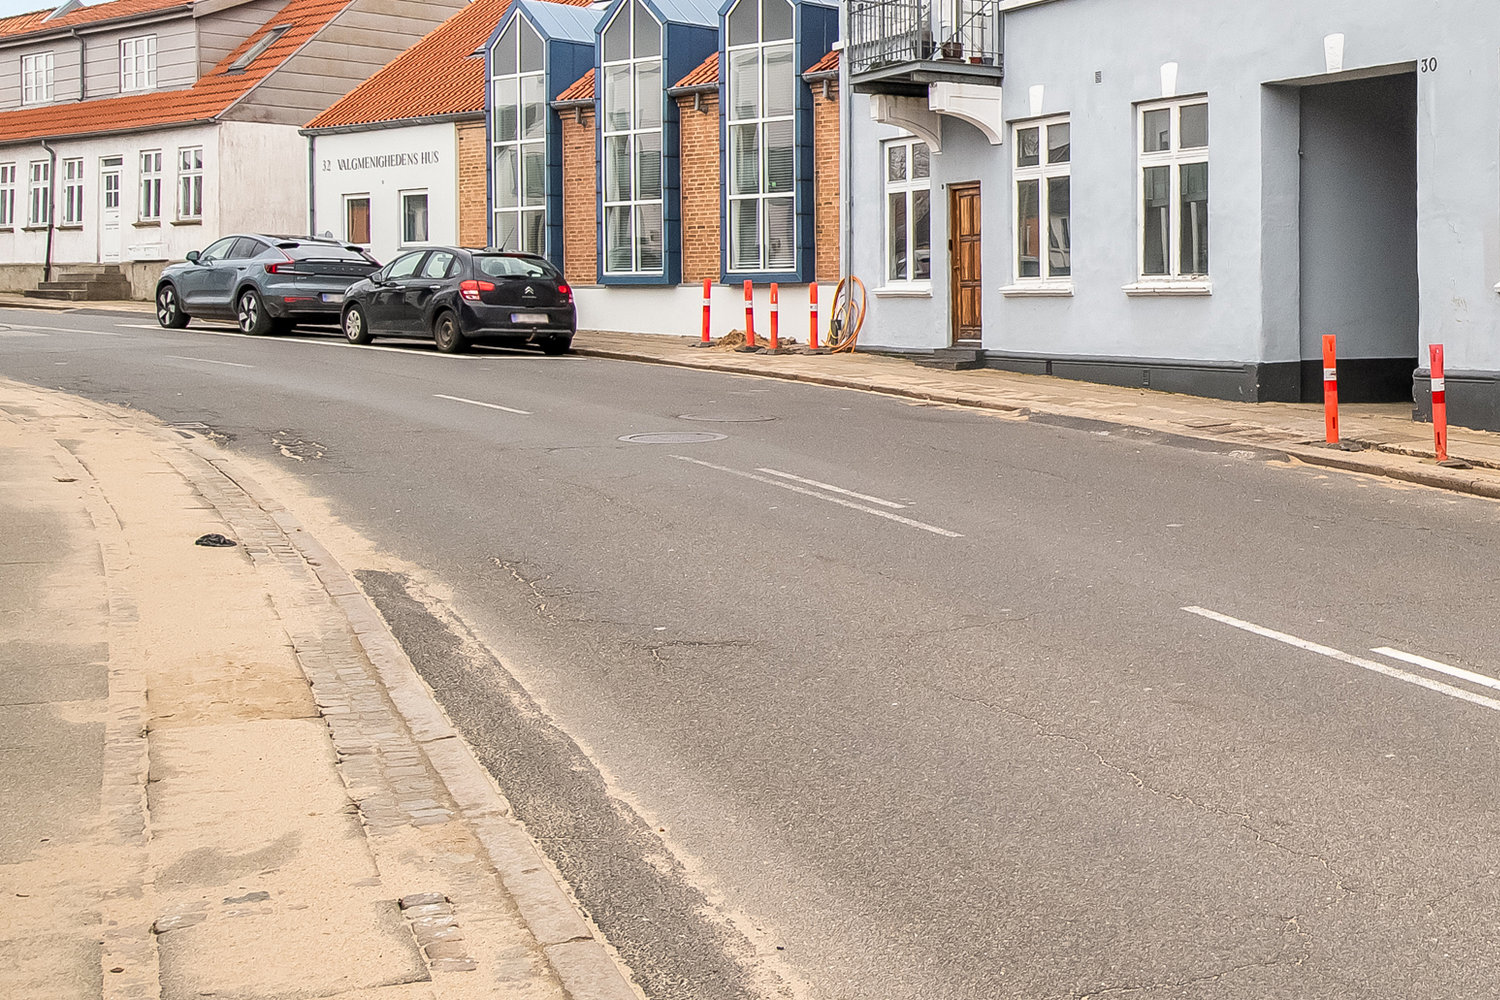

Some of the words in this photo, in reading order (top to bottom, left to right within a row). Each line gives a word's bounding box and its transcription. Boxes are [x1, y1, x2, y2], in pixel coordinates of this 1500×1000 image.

[1421, 57, 1438, 73] 30
[322, 159, 331, 171] 32
[337, 152, 418, 171] VALGMENIGHEDENS
[421, 150, 440, 165] HUS
